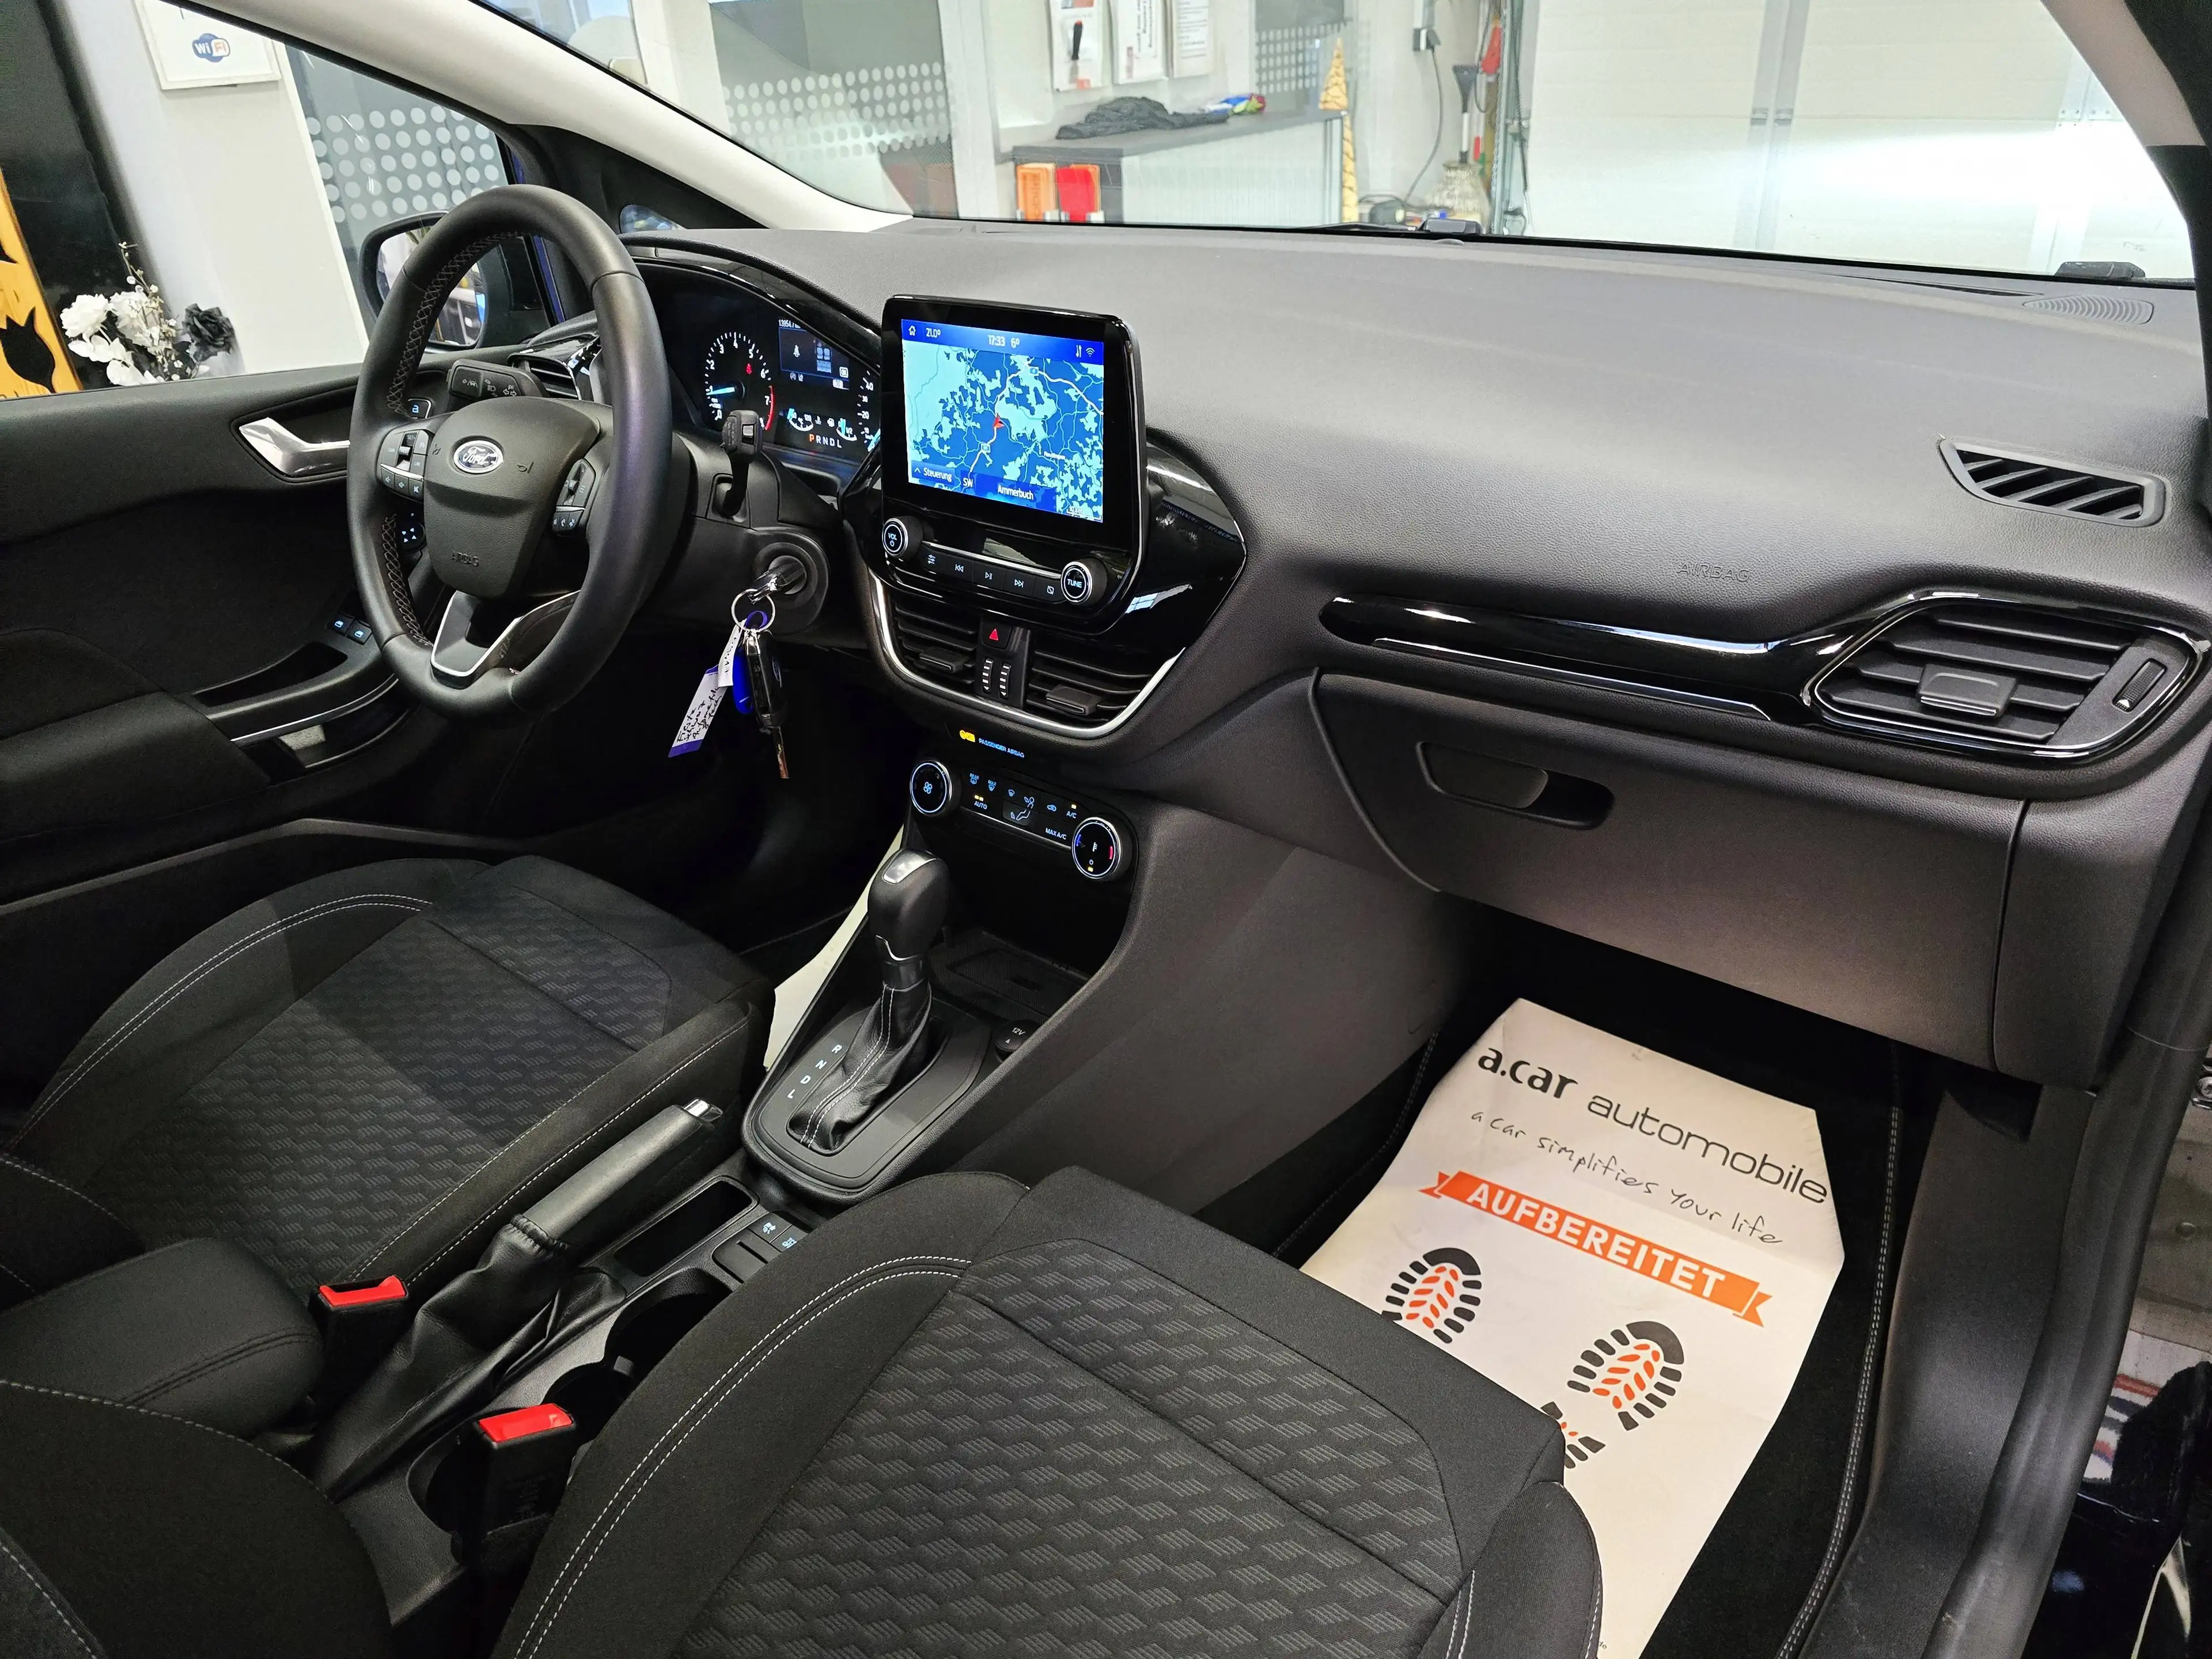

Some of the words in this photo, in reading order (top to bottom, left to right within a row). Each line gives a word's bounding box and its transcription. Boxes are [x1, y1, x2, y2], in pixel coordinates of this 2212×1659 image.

[719, 344, 724, 354] 3
[749, 349, 753, 358] 5
[710, 359, 715, 370] 2
[760, 368, 766, 378] 6
[764, 395, 770, 406] 7
[463, 446, 497, 465] Ford
[923, 467, 952, 482] Steuerung
[963, 477, 974, 488] SW
[997, 484, 1034, 500] Ammerbuch
[888, 532, 897, 540] VOL
[1676, 563, 1751, 582] AIRBAG
[1067, 578, 1082, 588] TUNE
[979, 738, 1006, 752] PASSENGER
[1007, 748, 1025, 758] AIRBAG
[974, 801, 987, 810] AUTO
[1066, 810, 1077, 819] A/C
[1045, 828, 1056, 837] MAX
[1056, 832, 1067, 840] A/C
[1012, 1027, 1025, 1035] 12V
[831, 1044, 842, 1054] R
[815, 1059, 827, 1070] N
[800, 1075, 811, 1084] D
[787, 1089, 796, 1099] L
[1478, 1048, 1578, 1099] a.car
[1587, 1095, 1827, 1203] automobile
[1471, 1111, 1484, 1123] a
[1490, 1118, 1526, 1139] car
[1537, 1137, 1659, 1194] simplifies
[1671, 1188, 1722, 1221] your
[1731, 1212, 1783, 1244] life
[1465, 1182, 1726, 1298] AUFBEREITET
